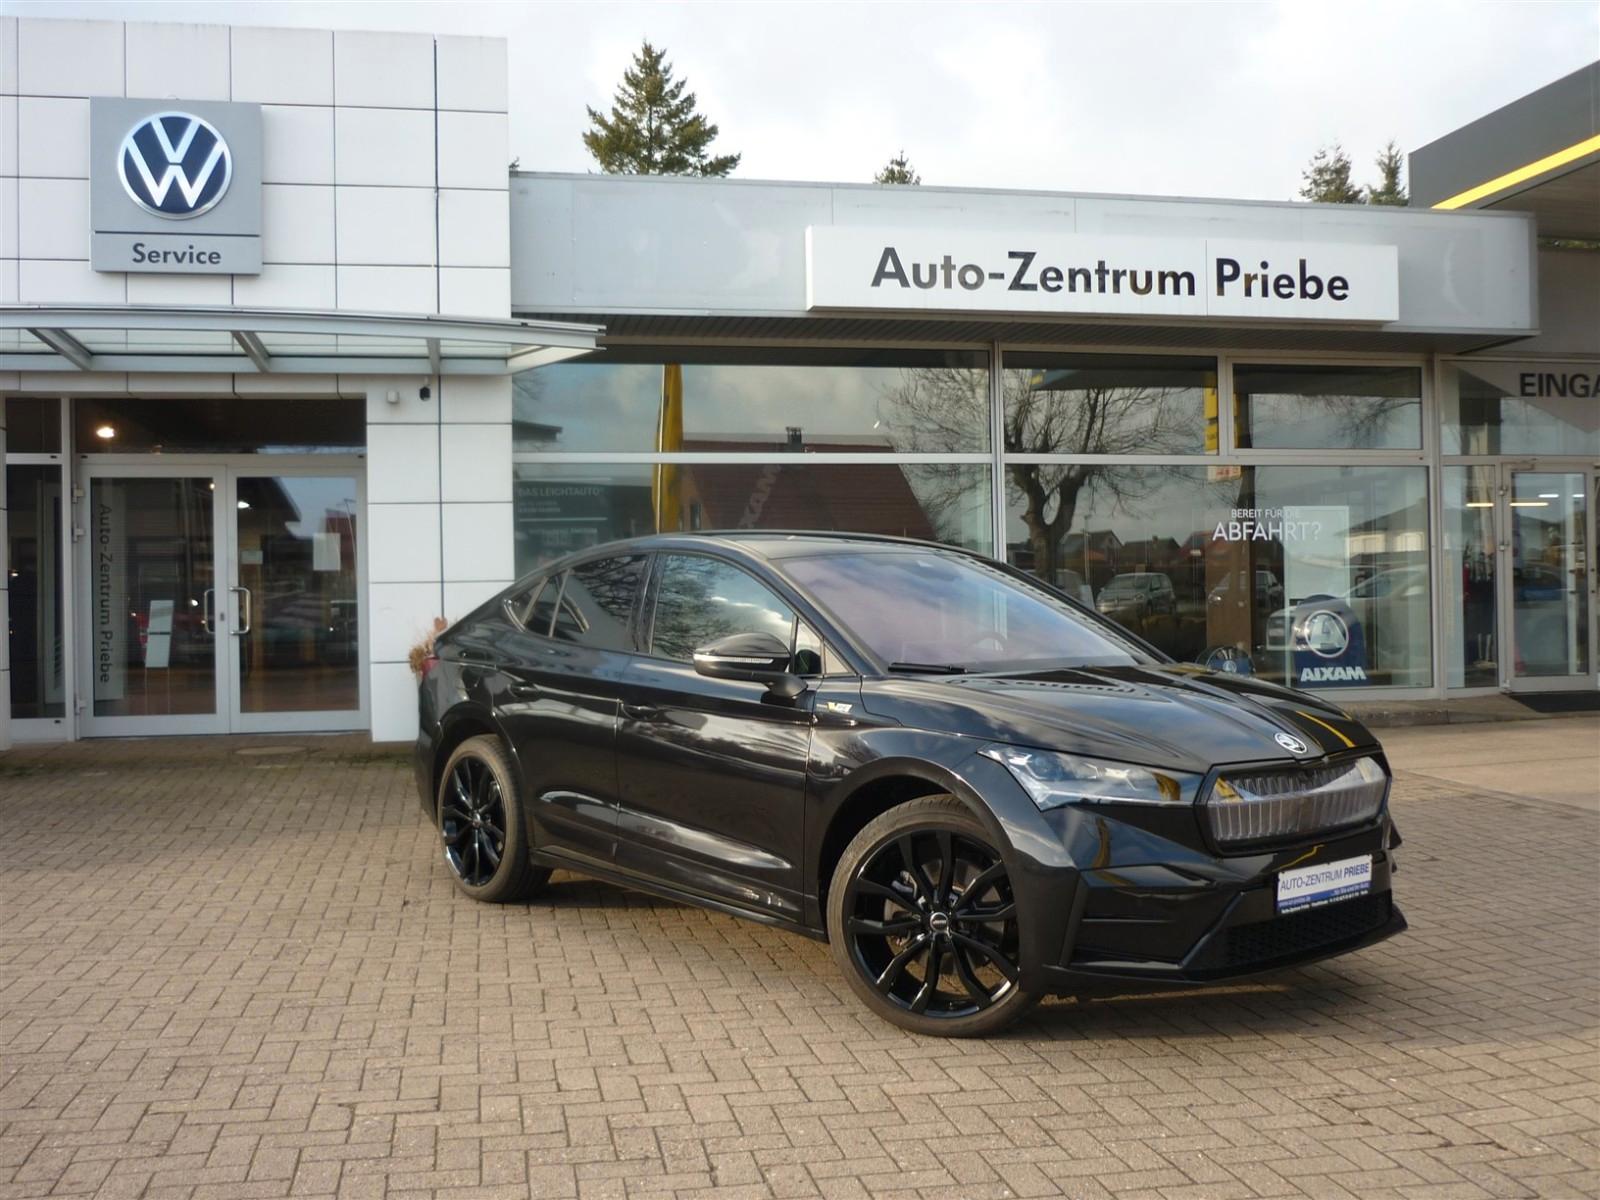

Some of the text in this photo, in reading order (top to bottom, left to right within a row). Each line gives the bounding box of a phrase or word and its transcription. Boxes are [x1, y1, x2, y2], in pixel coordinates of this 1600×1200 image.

[132, 243, 221, 265] Service
[871, 246, 1351, 301] Auto-Zentrum Priebe
[1231, 508, 1262, 519] BEREIT
[1212, 520, 1322, 542] ABFAHRT?
[99, 504, 114, 684] Auto-Zentrum Priebe
[1300, 666, 1367, 682] AIXAM
[1280, 870, 1342, 891] AUTO-ZENTRUM
[1344, 863, 1369, 877] PRIEBE
